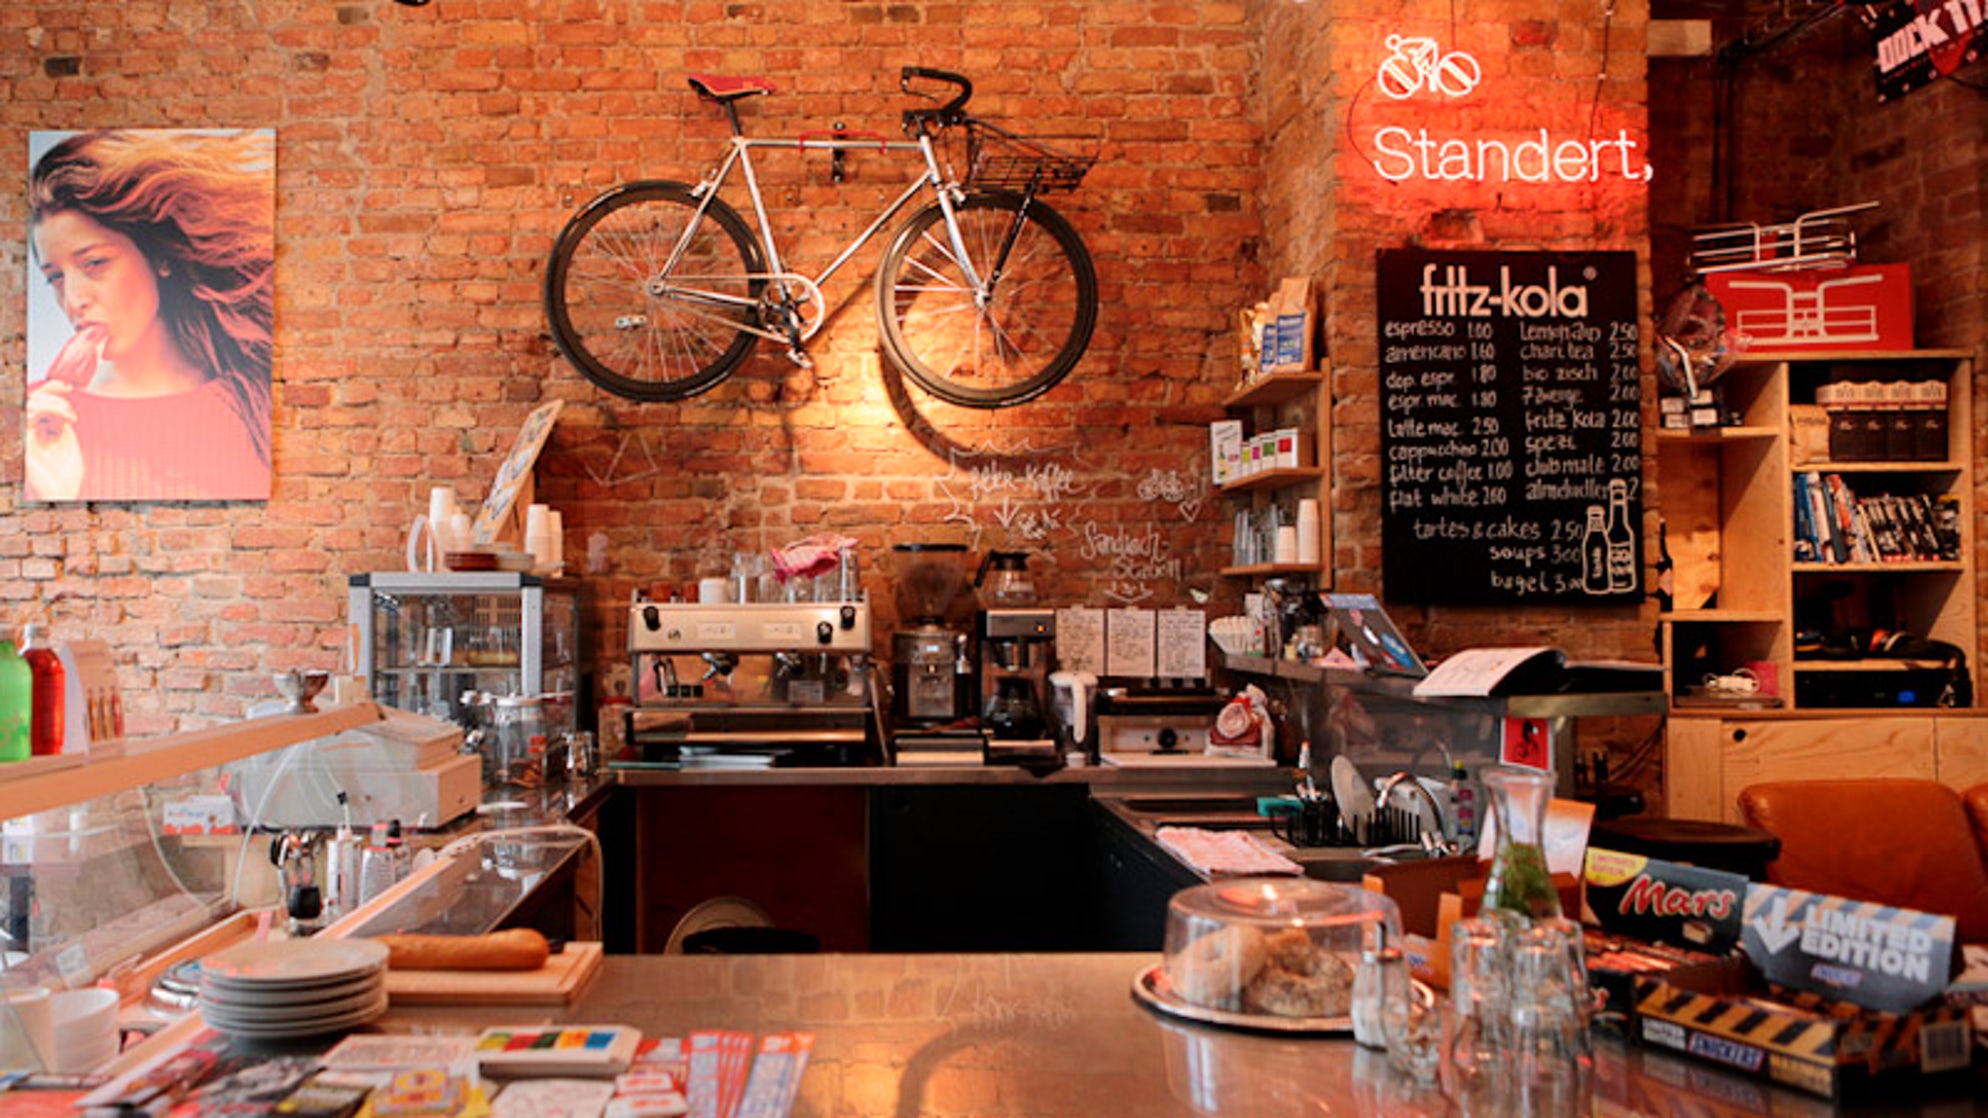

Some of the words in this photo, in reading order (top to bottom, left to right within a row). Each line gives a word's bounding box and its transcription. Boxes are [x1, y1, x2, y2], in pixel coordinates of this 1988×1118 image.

[1384, 320, 1455, 342] espresso
[1384, 343, 1467, 364] americano
[1438, 460, 1485, 489] coffee
[1430, 485, 1479, 508] white
[1413, 516, 1470, 540] tartes
[1486, 514, 1541, 540] cakes
[1489, 546, 1547, 568] soups
[1490, 570, 1551, 596] bagel
[1618, 874, 1737, 920] Mars
[1805, 904, 1933, 951] LIMITED
[1800, 930, 1931, 983] EDITION
